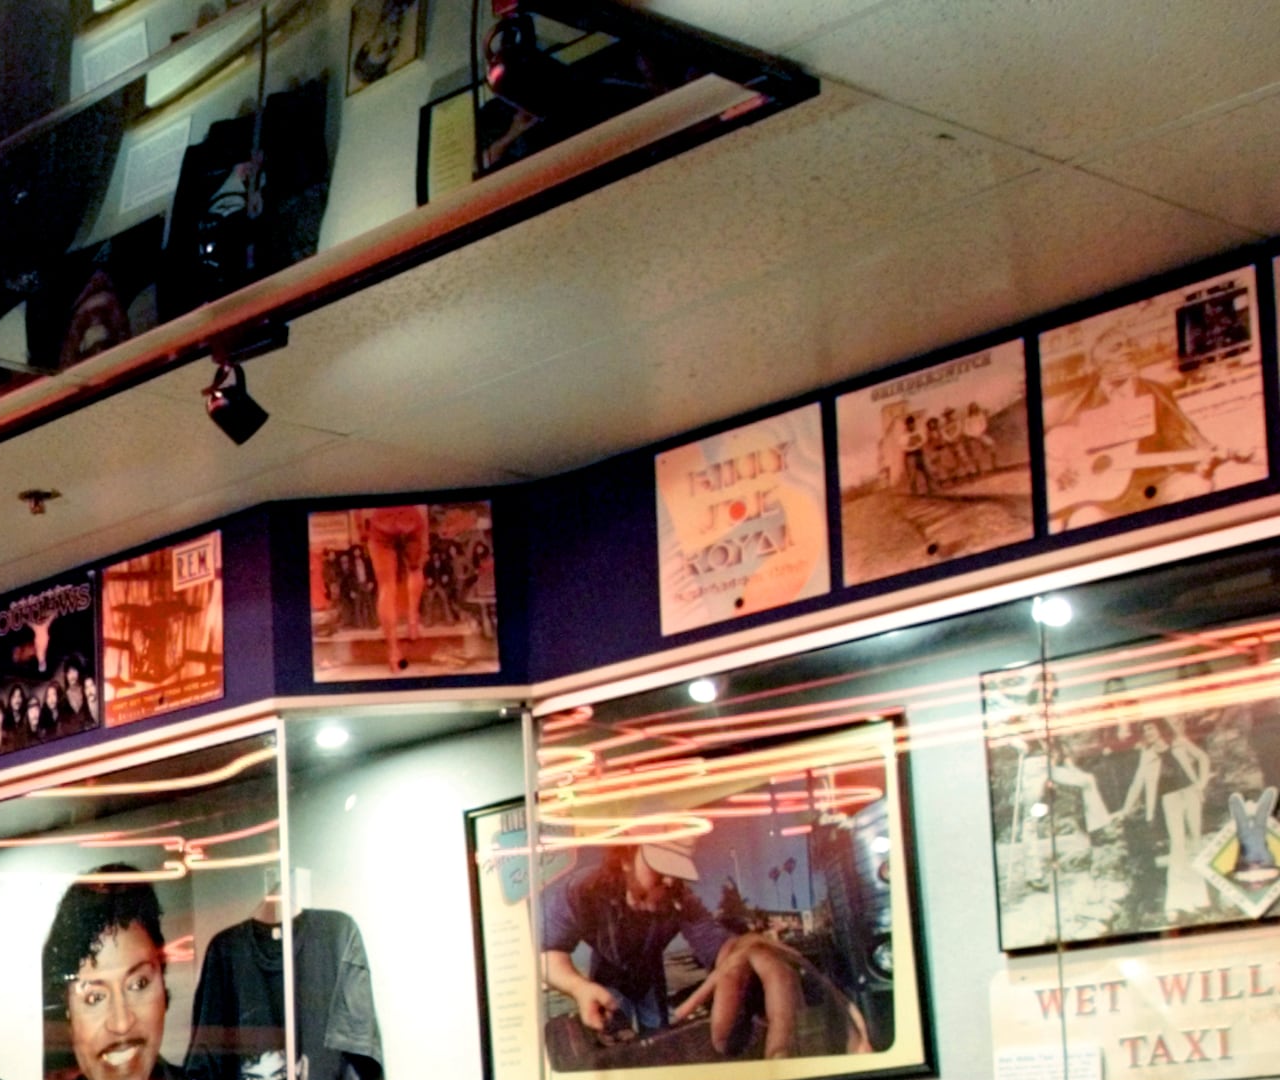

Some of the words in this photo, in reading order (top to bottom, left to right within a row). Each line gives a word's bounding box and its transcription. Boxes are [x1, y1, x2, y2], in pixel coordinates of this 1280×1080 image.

[1035, 980, 1128, 1020] WET
[1156, 963, 1280, 1006] WILL
[1120, 1027, 1233, 1070] TAXI
